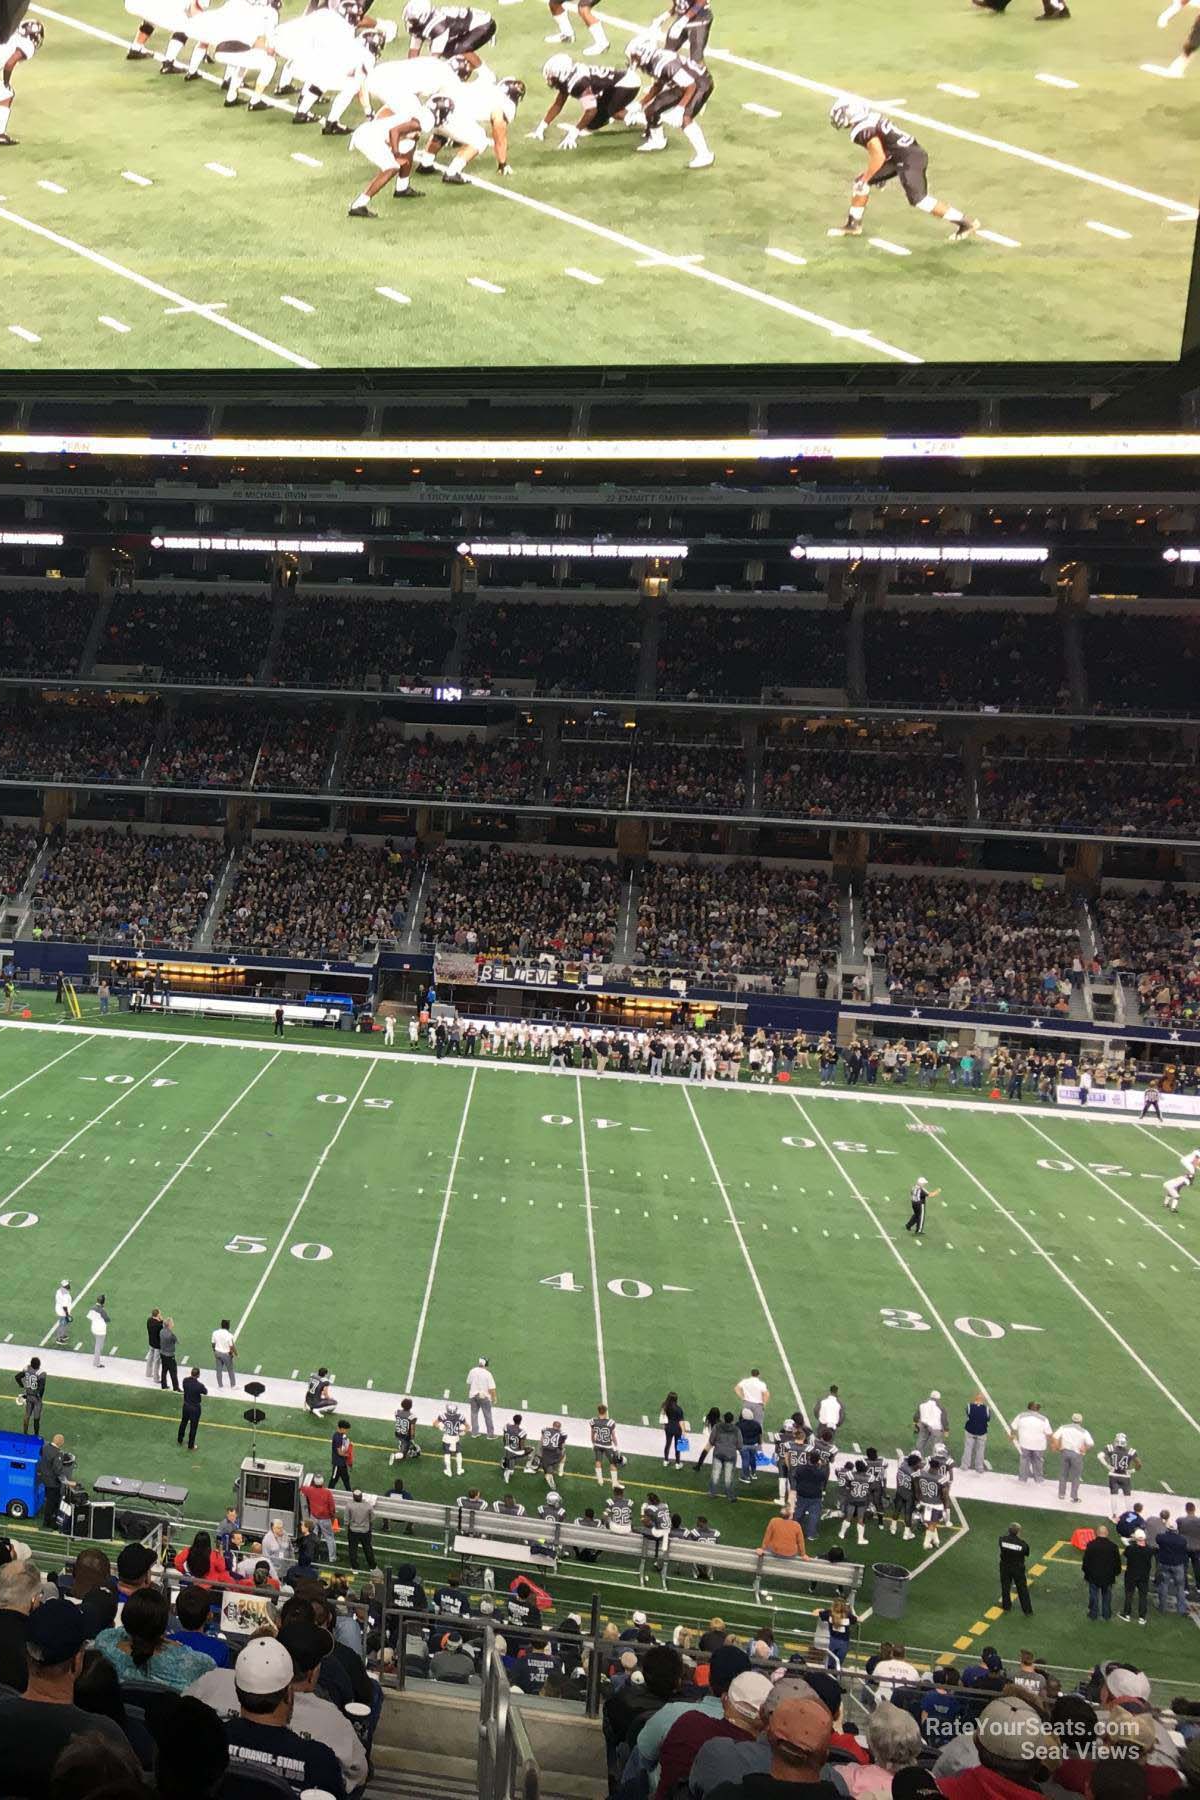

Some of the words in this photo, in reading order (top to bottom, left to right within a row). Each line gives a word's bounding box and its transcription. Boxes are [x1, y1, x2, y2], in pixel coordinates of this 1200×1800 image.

[224, 1235, 333, 1260] 50
[539, 1272, 653, 1298] 40
[880, 1308, 1006, 1339] 30
[1111, 1453, 1129, 1471] 14
[850, 1481, 869, 1498] 36
[612, 1507, 632, 1526] 22
[1014, 1676, 1041, 1689] HEART
[276, 1756, 305, 1772] STARK
